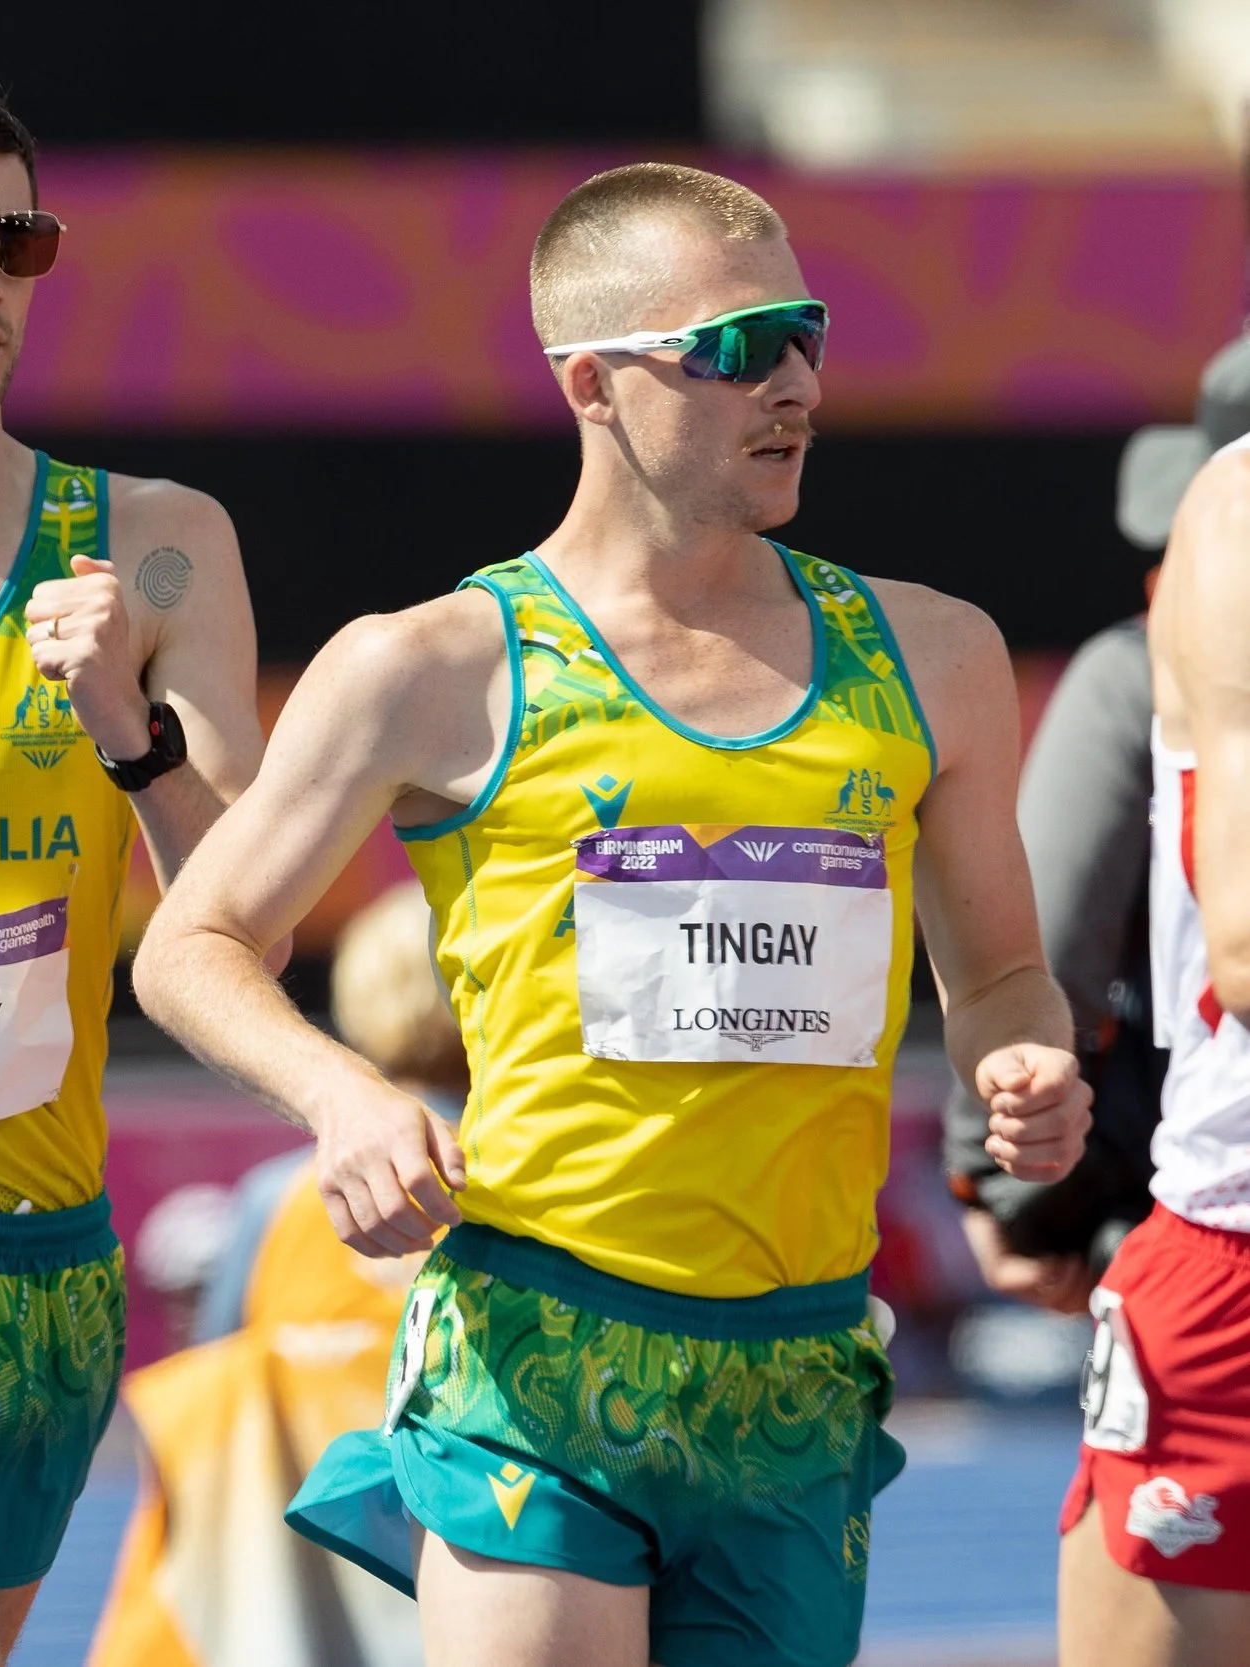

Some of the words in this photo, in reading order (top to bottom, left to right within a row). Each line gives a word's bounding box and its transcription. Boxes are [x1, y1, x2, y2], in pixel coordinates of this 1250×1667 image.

[36, 684, 50, 729] AUS
[860, 768, 872, 815] AUS
[595, 839, 683, 855] BIRMINGHAM
[792, 842, 882, 859] commonwea
[621, 855, 657, 870] 2022
[820, 855, 862, 870] games
[680, 922, 818, 966] TINGAY
[673, 1007, 831, 1033] LONGINES
